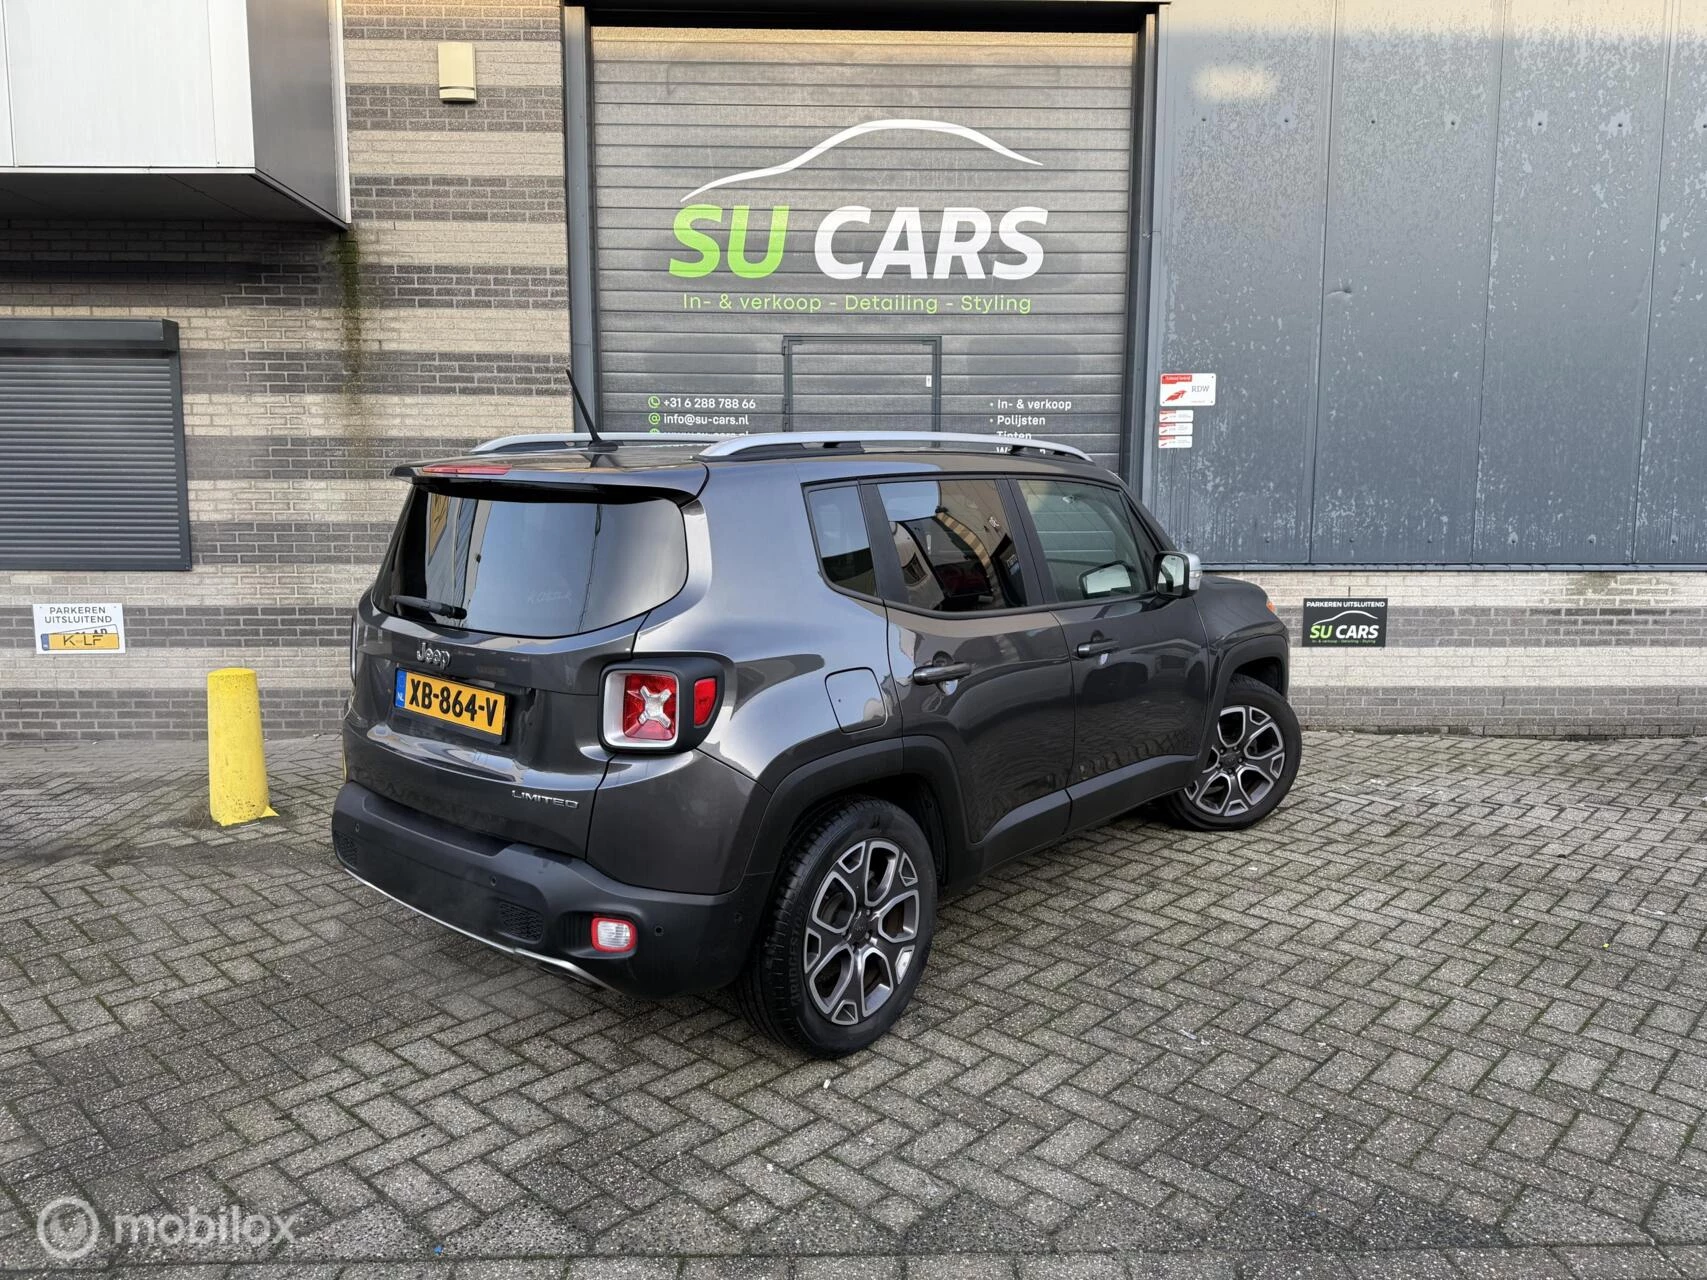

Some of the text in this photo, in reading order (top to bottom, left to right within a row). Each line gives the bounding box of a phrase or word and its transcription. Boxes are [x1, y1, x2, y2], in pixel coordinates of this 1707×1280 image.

[669, 203, 1049, 280] SU CARS
[683, 293, 711, 309] In-
[719, 293, 732, 309] &
[740, 294, 821, 313] verkoop
[845, 295, 938, 314] Detailing
[960, 295, 1031, 314] Styling
[1191, 385, 1210, 393] RDW
[663, 397, 757, 409] +31 6 288 788 66
[997, 399, 1072, 411] In- & verkoop
[663, 413, 749, 426] info@su-cars.nl
[997, 415, 1046, 427] Polijsten
[49, 606, 106, 615] PARKEREN
[44, 615, 112, 624] UITSLUITEND
[1309, 625, 1379, 639] SU CARS
[416, 642, 450, 670] Jeep
[408, 678, 498, 727] XB-864-V
[511, 789, 580, 809] LIMITED
